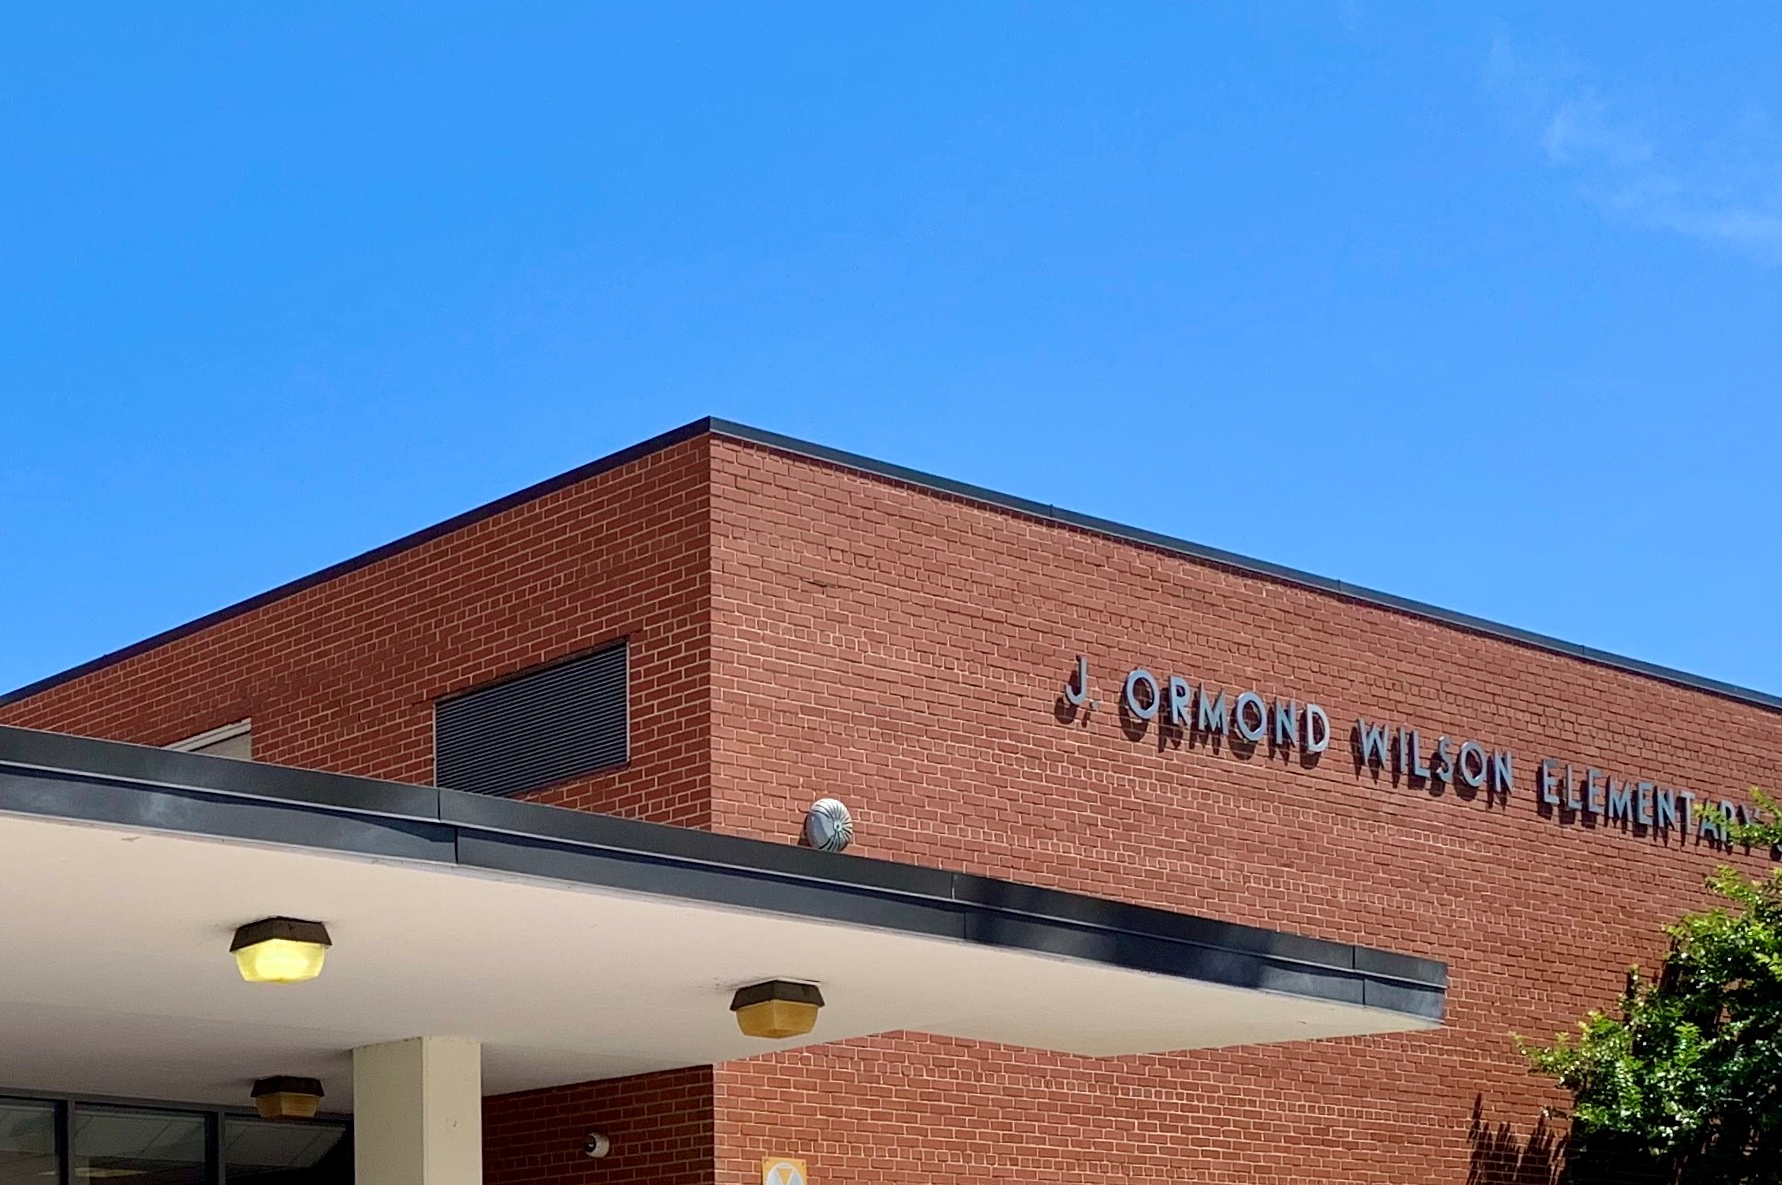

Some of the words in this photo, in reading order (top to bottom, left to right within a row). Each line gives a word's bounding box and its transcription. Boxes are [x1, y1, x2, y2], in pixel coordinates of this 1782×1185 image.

[1065, 655, 1099, 710] J.
[1125, 668, 1331, 752] ORMOND
[1356, 717, 1513, 794] WILSON
